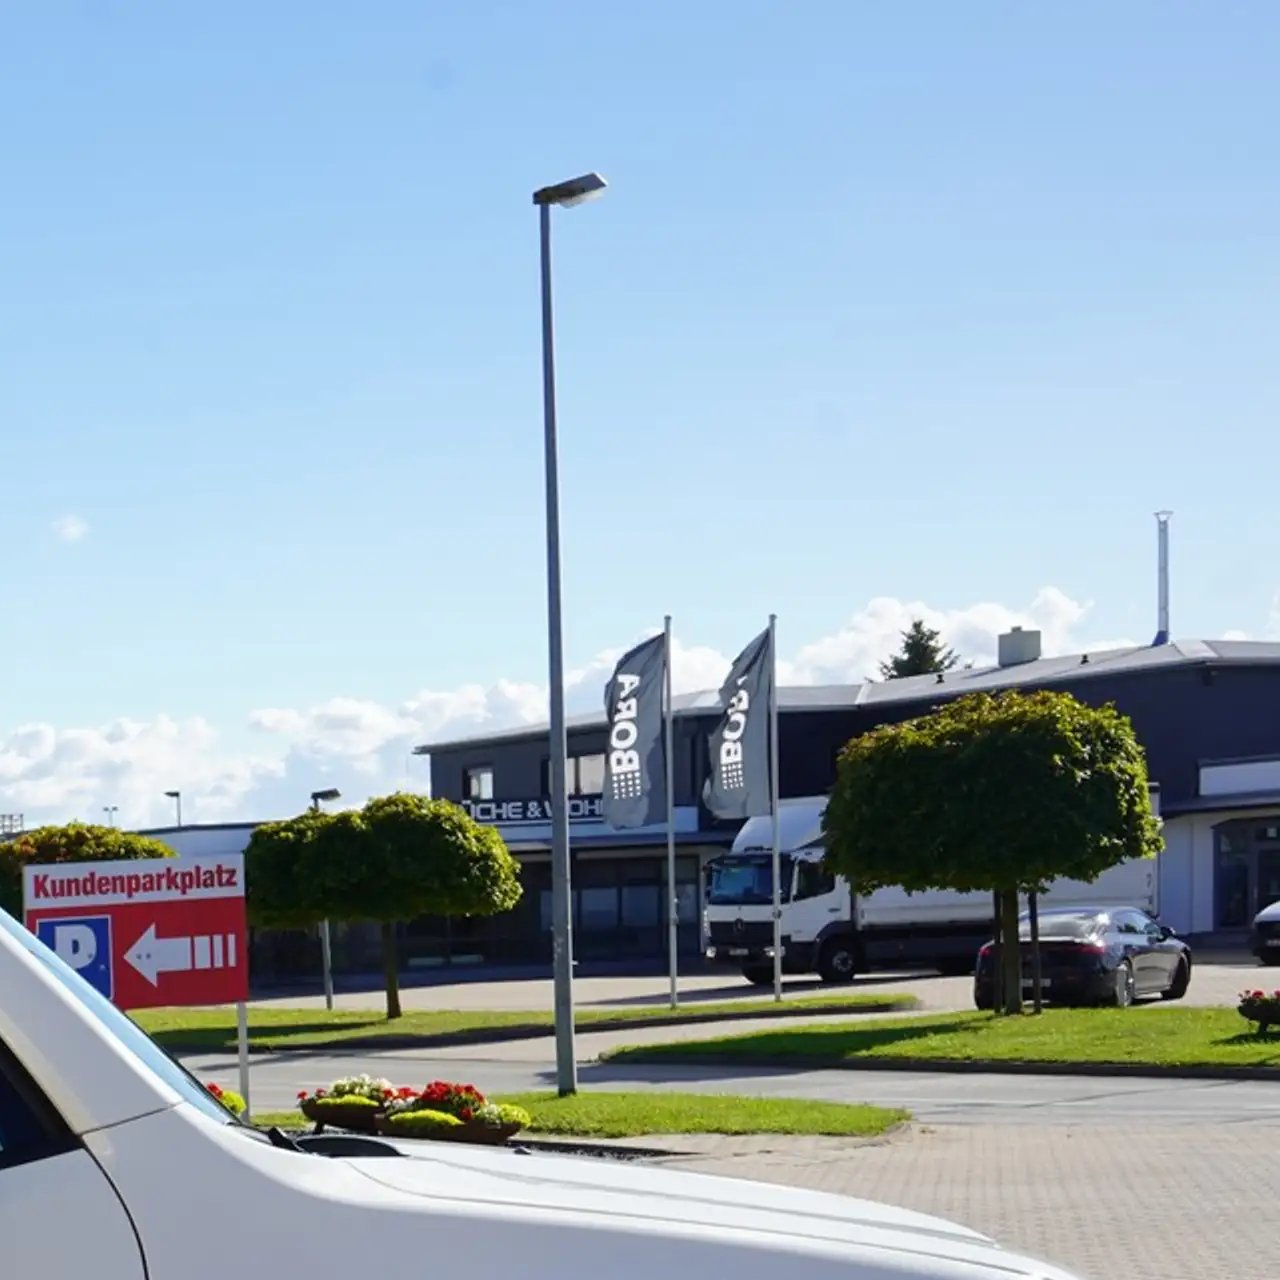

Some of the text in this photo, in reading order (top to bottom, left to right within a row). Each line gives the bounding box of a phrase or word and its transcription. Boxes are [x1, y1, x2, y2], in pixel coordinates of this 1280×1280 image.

[610, 673, 641, 774] BORA
[720, 675, 749, 755] BOR
[460, 799, 523, 820] ÜCHE
[527, 801, 542, 819] &
[33, 864, 238, 900] Kundenparkplatz
[54, 923, 97, 970] P
